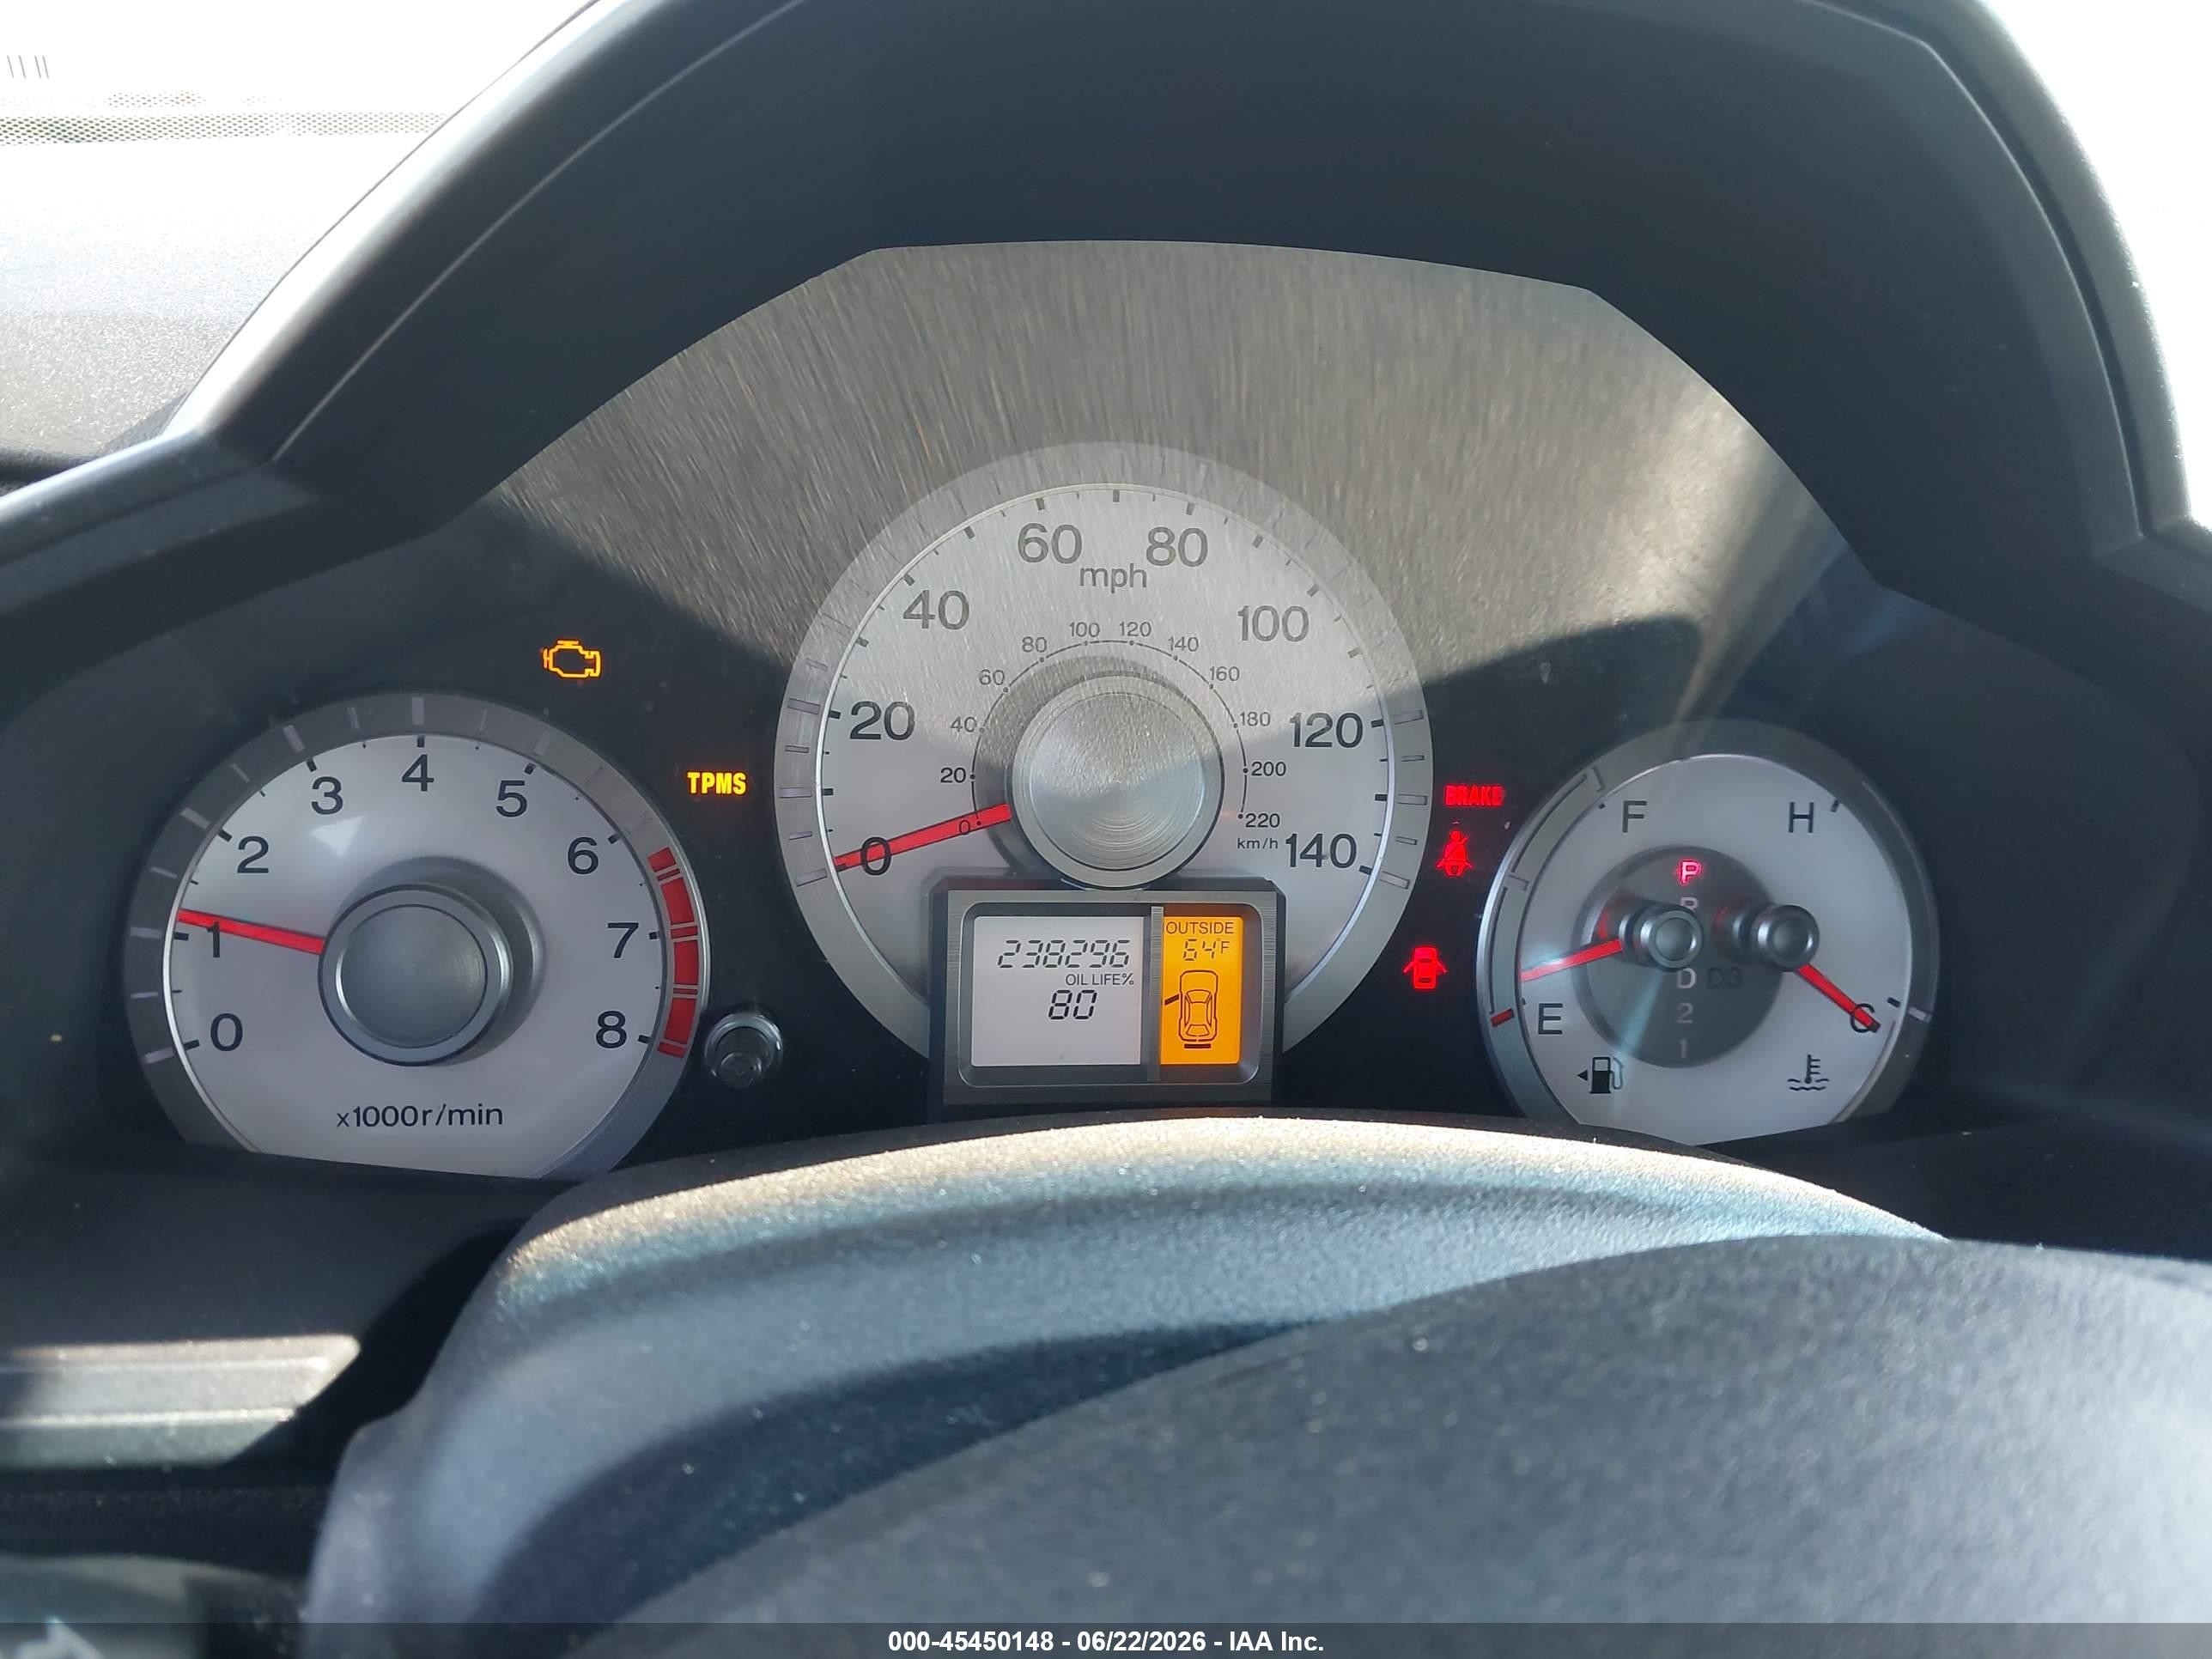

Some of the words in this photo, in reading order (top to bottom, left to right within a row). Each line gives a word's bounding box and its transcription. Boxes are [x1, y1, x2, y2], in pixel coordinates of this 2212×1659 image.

[1018, 523, 1082, 563] 60
[1146, 527, 1207, 568] 80
[1079, 562, 1147, 592] mph
[903, 590, 969, 630] 40
[1237, 605, 1309, 643] 100
[1022, 636, 1047, 653] 80
[1070, 622, 1100, 638] 100
[1120, 622, 1152, 637] 120
[1168, 636, 1199, 652] 140
[979, 669, 1005, 685] 60
[1209, 666, 1240, 682] 160
[849, 701, 915, 740] 20
[951, 717, 976, 732] 40
[1240, 712, 1271, 726] 180
[1289, 713, 1363, 748] 120
[402, 754, 434, 792] 4
[687, 771, 746, 794] TPMS
[940, 768, 966, 783] 20
[1251, 763, 1285, 776] 200
[312, 776, 343, 814] 3
[496, 781, 527, 817] 5
[1444, 784, 1504, 806] BRAKE
[1245, 813, 1279, 828] 220
[1622, 800, 1647, 833] F
[1789, 802, 1814, 833] H
[238, 836, 269, 872] 2
[567, 837, 599, 874] 6
[860, 836, 891, 876] 0
[1237, 837, 1278, 849] km/h
[1285, 833, 1357, 868] 140
[1680, 860, 1702, 884] P
[206, 922, 222, 957] 1
[607, 923, 639, 958] 7
[1165, 921, 1234, 934] OUTSIDE
[997, 939, 1131, 968] 238296
[1066, 973, 1088, 986] OIL
[1092, 972, 1134, 986] LIFE%
[1677, 968, 1696, 988] D
[1048, 989, 1098, 1020] 80
[1538, 1004, 1563, 1035] E
[1677, 1003, 1694, 1024] 2
[1850, 1003, 1875, 1033] C
[210, 1013, 242, 1050] 0
[595, 1012, 627, 1048] 8
